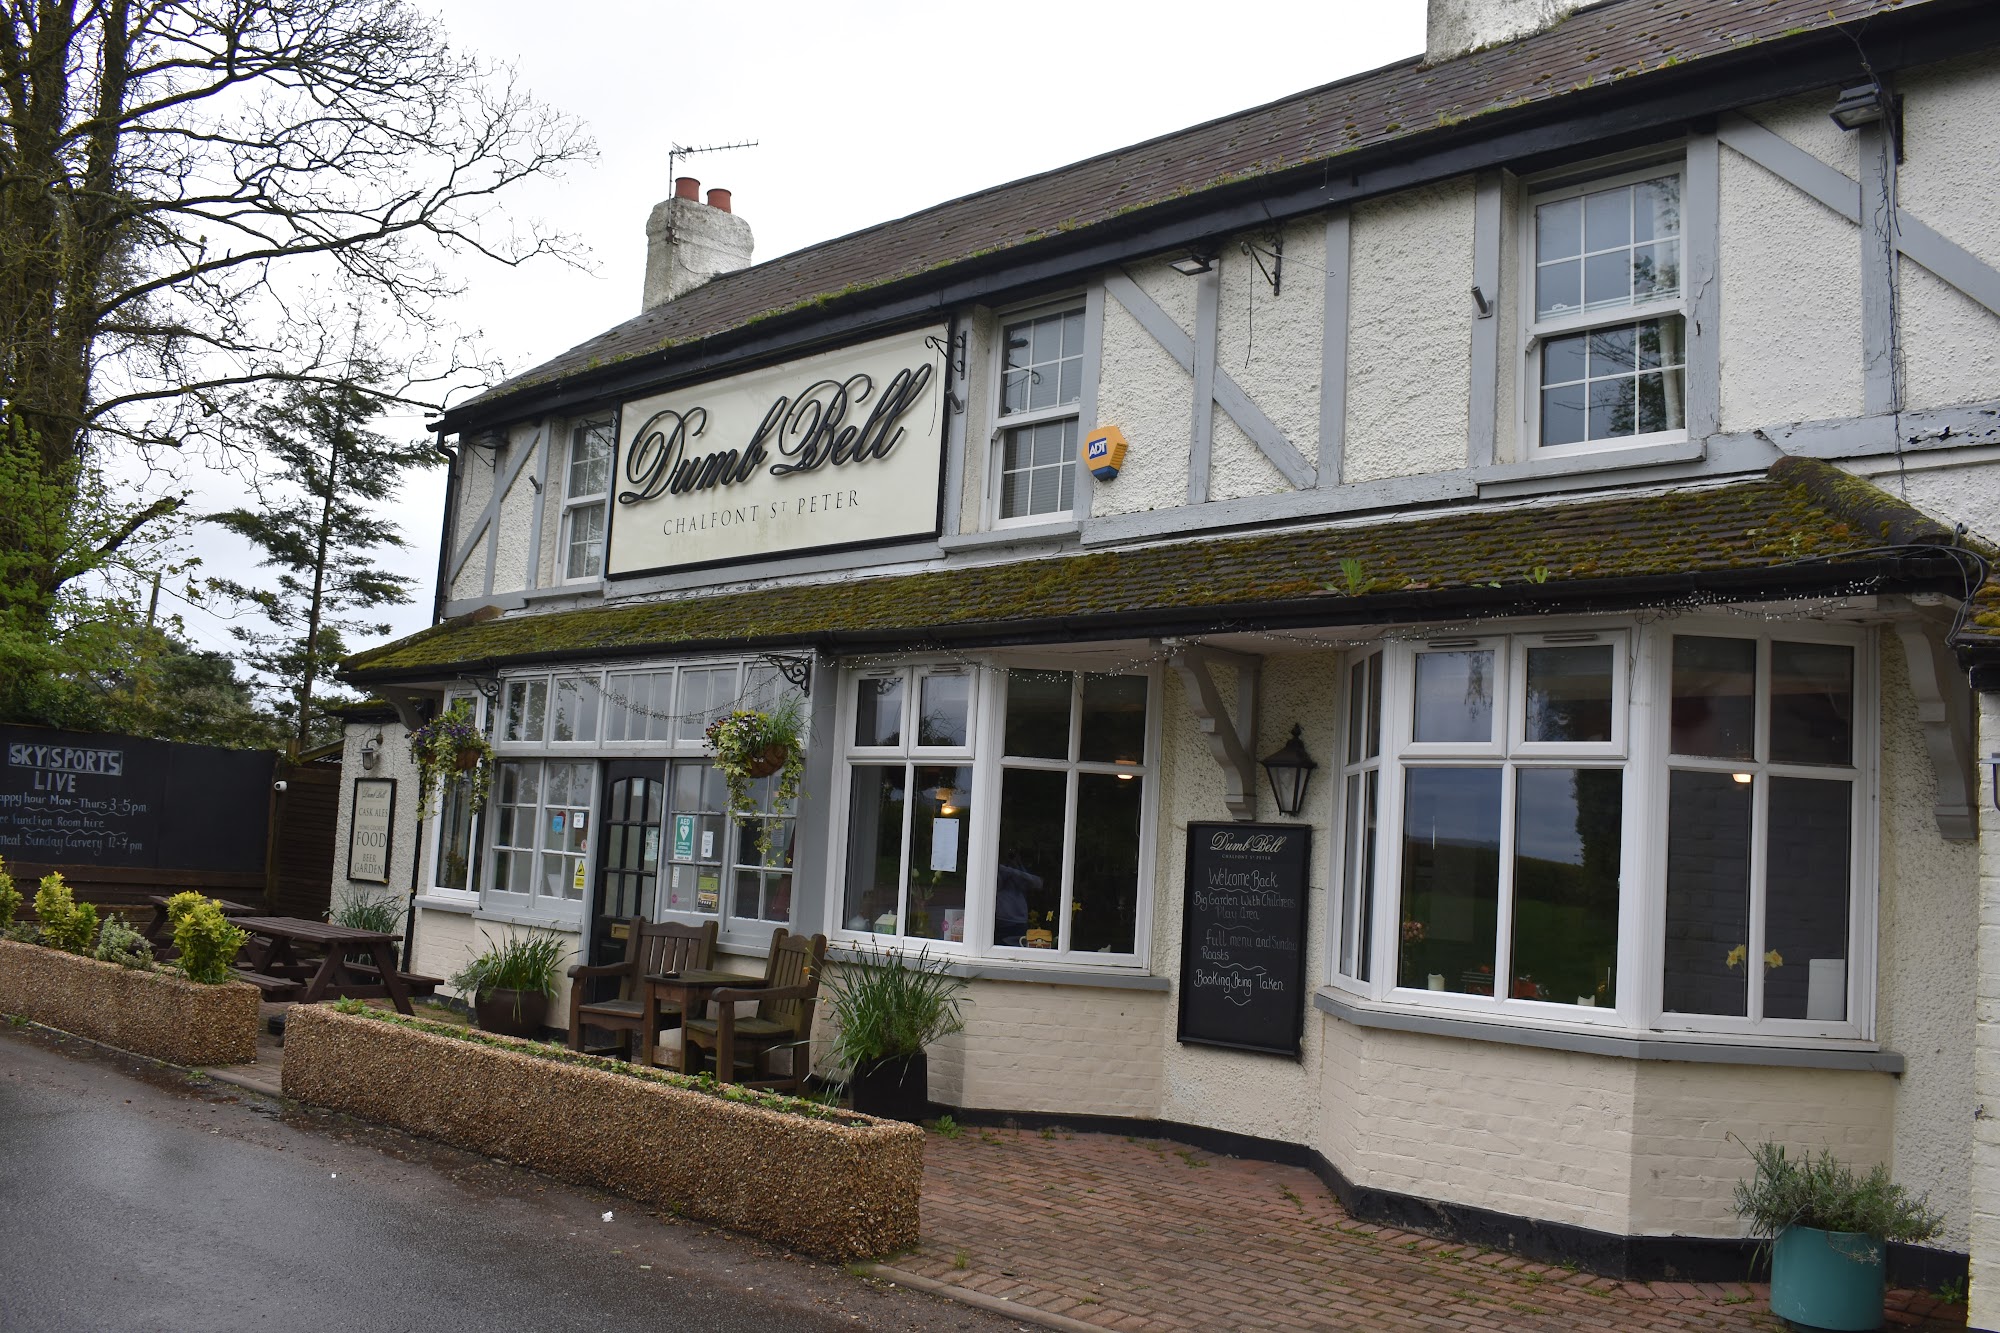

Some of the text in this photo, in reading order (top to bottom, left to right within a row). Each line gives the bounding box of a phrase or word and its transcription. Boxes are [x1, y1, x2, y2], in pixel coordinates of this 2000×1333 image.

[618, 363, 932, 504] Dumb Bell
[1089, 440, 1107, 457] ADT
[663, 504, 759, 536] CHALFONT
[798, 489, 860, 516] PETER
[11, 745, 120, 775] SKY SPORTS
[34, 771, 76, 793] LIVE
[24, 792, 46, 804] hour
[358, 807, 389, 818] CASK ALES
[57, 816, 81, 827] Room
[84, 816, 104, 828] hire
[680, 818, 691, 826] AED
[25, 833, 63, 855] Sunday
[66, 835, 103, 856] Carvery
[356, 831, 387, 848] FOOD
[1210, 831, 1287, 853] Dumb Bell
[362, 853, 377, 863] BEER
[354, 863, 384, 875] GARDEN
[1208, 867, 1278, 890] Welcome Back
[1193, 891, 1208, 911] Big
[1208, 892, 1238, 906] Garden
[1261, 894, 1296, 908] Childrens
[1215, 906, 1237, 920] Play
[1229, 935, 1253, 948] menu
[1255, 935, 1271, 948] and
[1201, 945, 1230, 961] Roasts
[1231, 971, 1252, 997] Being
